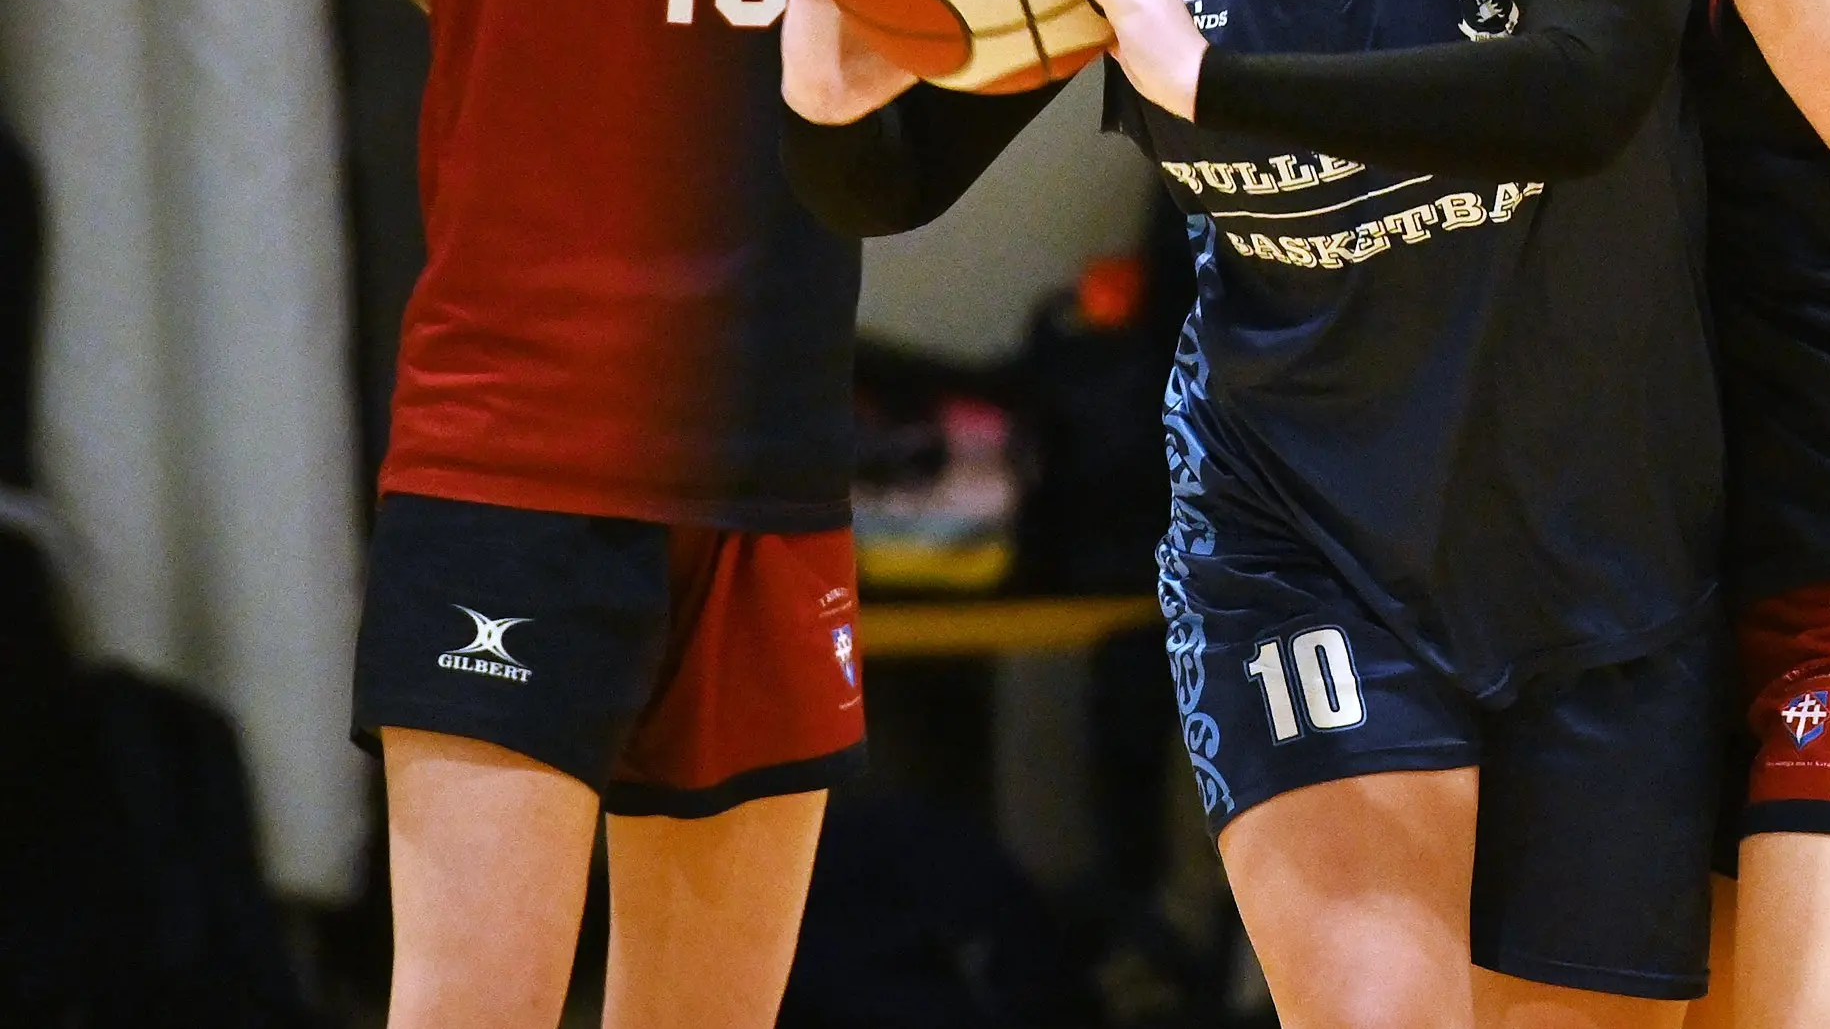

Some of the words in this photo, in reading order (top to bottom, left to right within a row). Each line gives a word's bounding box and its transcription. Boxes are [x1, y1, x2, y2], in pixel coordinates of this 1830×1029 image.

[1161, 151, 1366, 195] BULLE
[1226, 181, 1545, 269] BASKETBA
[438, 653, 533, 683] GILBERT
[1244, 625, 1368, 747] 10
